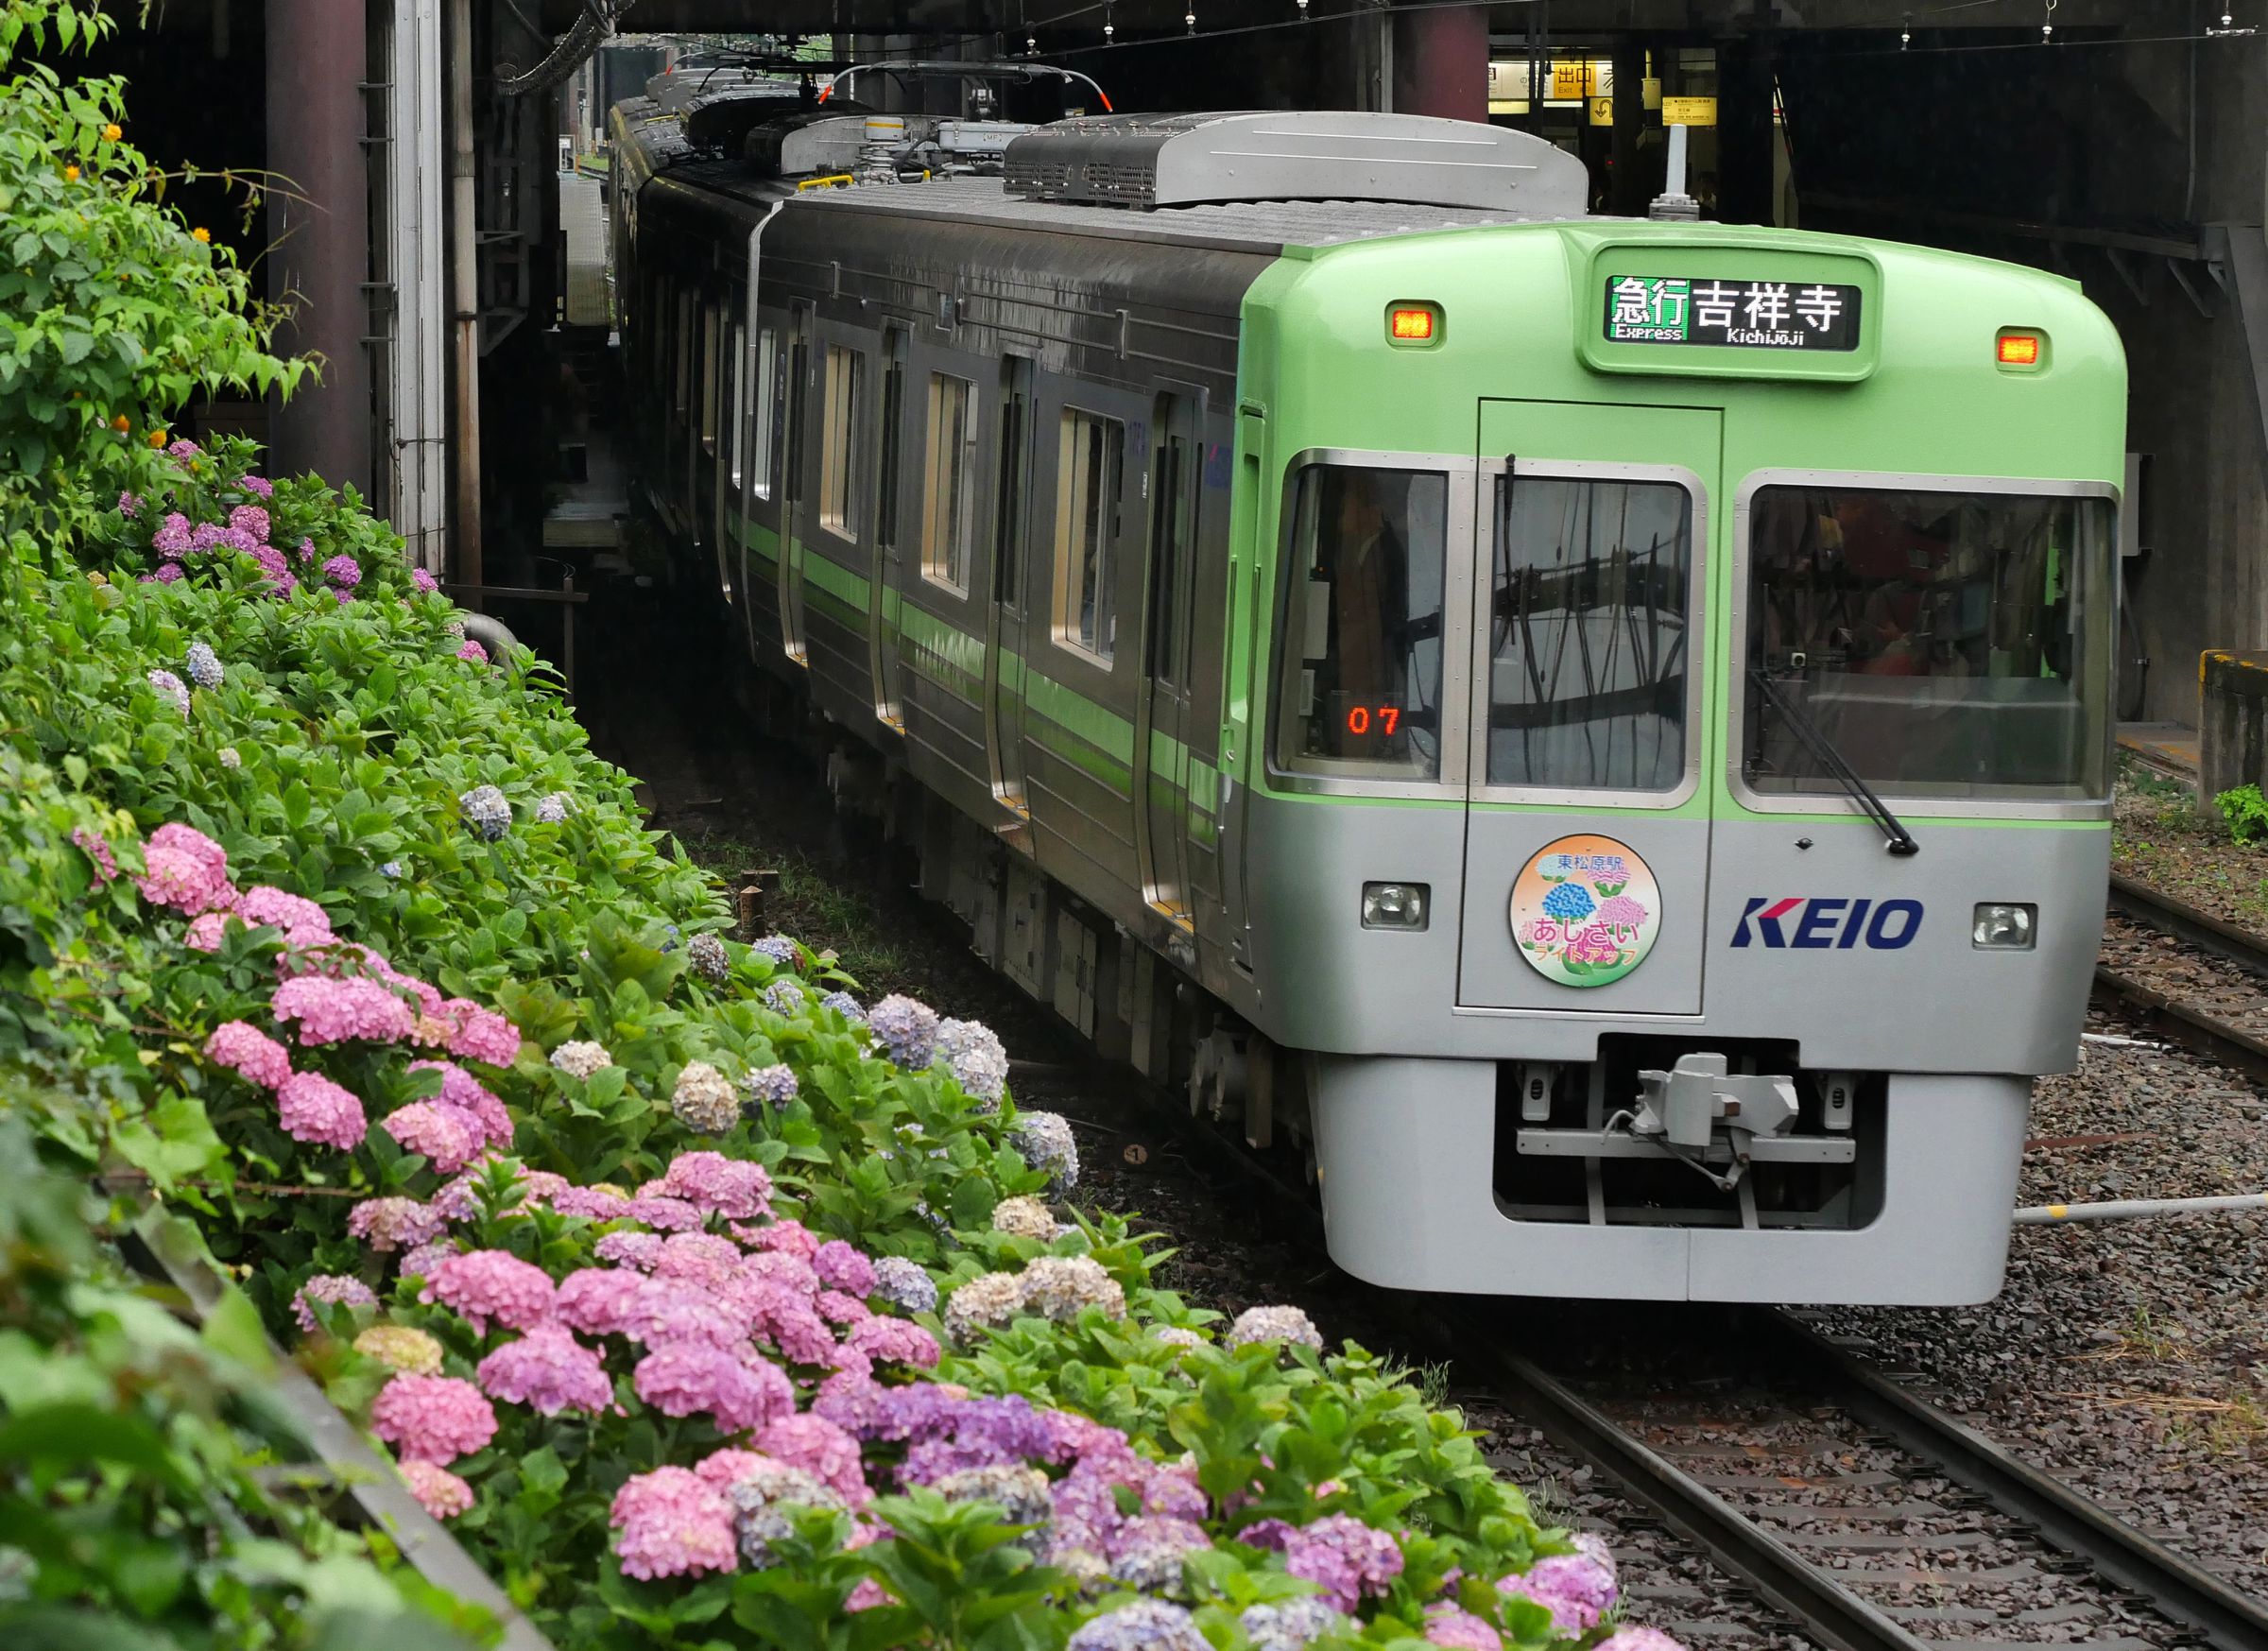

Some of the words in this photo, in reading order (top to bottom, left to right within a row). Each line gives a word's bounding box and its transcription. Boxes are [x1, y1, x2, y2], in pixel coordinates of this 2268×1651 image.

[1612, 277, 1689, 325] 急行
[1692, 281, 1842, 332] 吉祥寺
[1615, 323, 1683, 340] Express
[1557, 854, 1624, 871] 東松原駅
[1533, 918, 1639, 944] あじさい
[1730, 897, 1924, 950] KEIO
